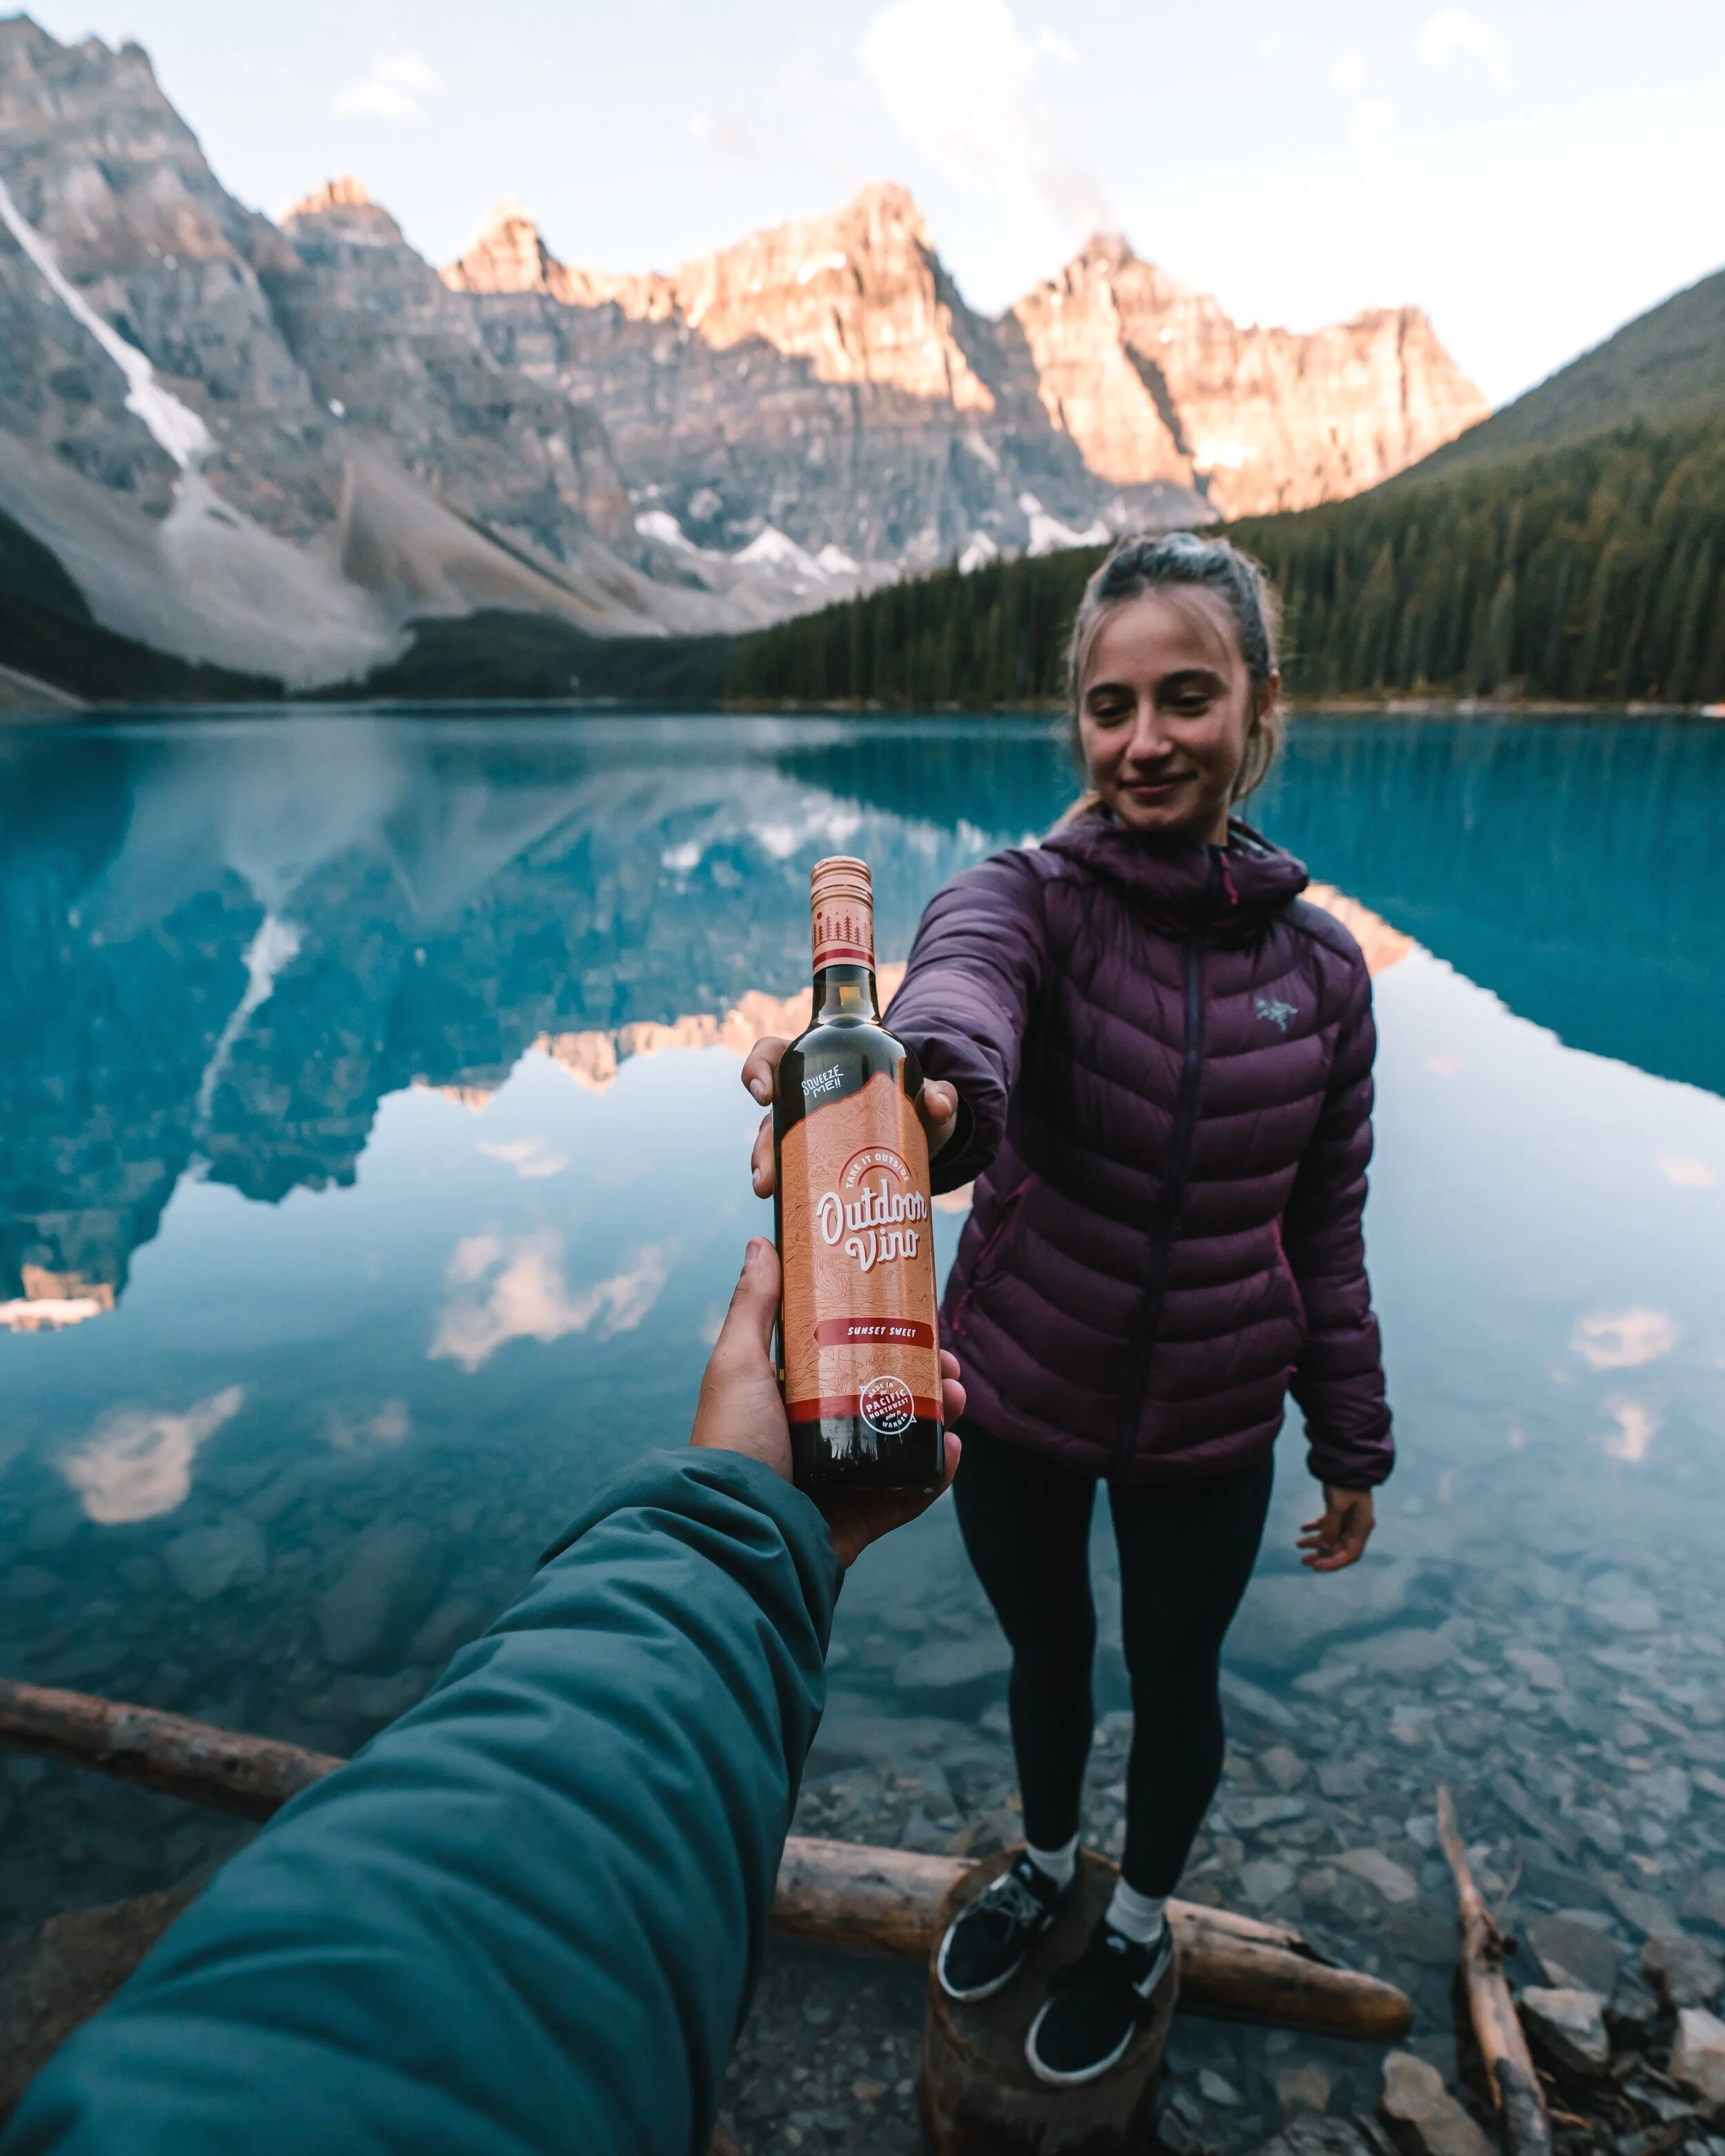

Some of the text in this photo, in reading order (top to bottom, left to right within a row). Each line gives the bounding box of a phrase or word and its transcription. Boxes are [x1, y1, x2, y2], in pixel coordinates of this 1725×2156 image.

[801, 1065, 844, 1096] SQUEEZE
[813, 1077, 841, 1098] ME!!
[846, 1153, 910, 1188] TAKE IT OUTSIDE
[816, 1178, 928, 1245] Outdoor
[845, 1228, 919, 1272] Vino
[847, 1326, 916, 1337] SUNSET SWEET
[865, 1389, 906, 1413] PACIFIC
[868, 1383, 885, 1398] MADE
[869, 1397, 909, 1419] NORTHWEST
[882, 1412, 908, 1428] WANDER
